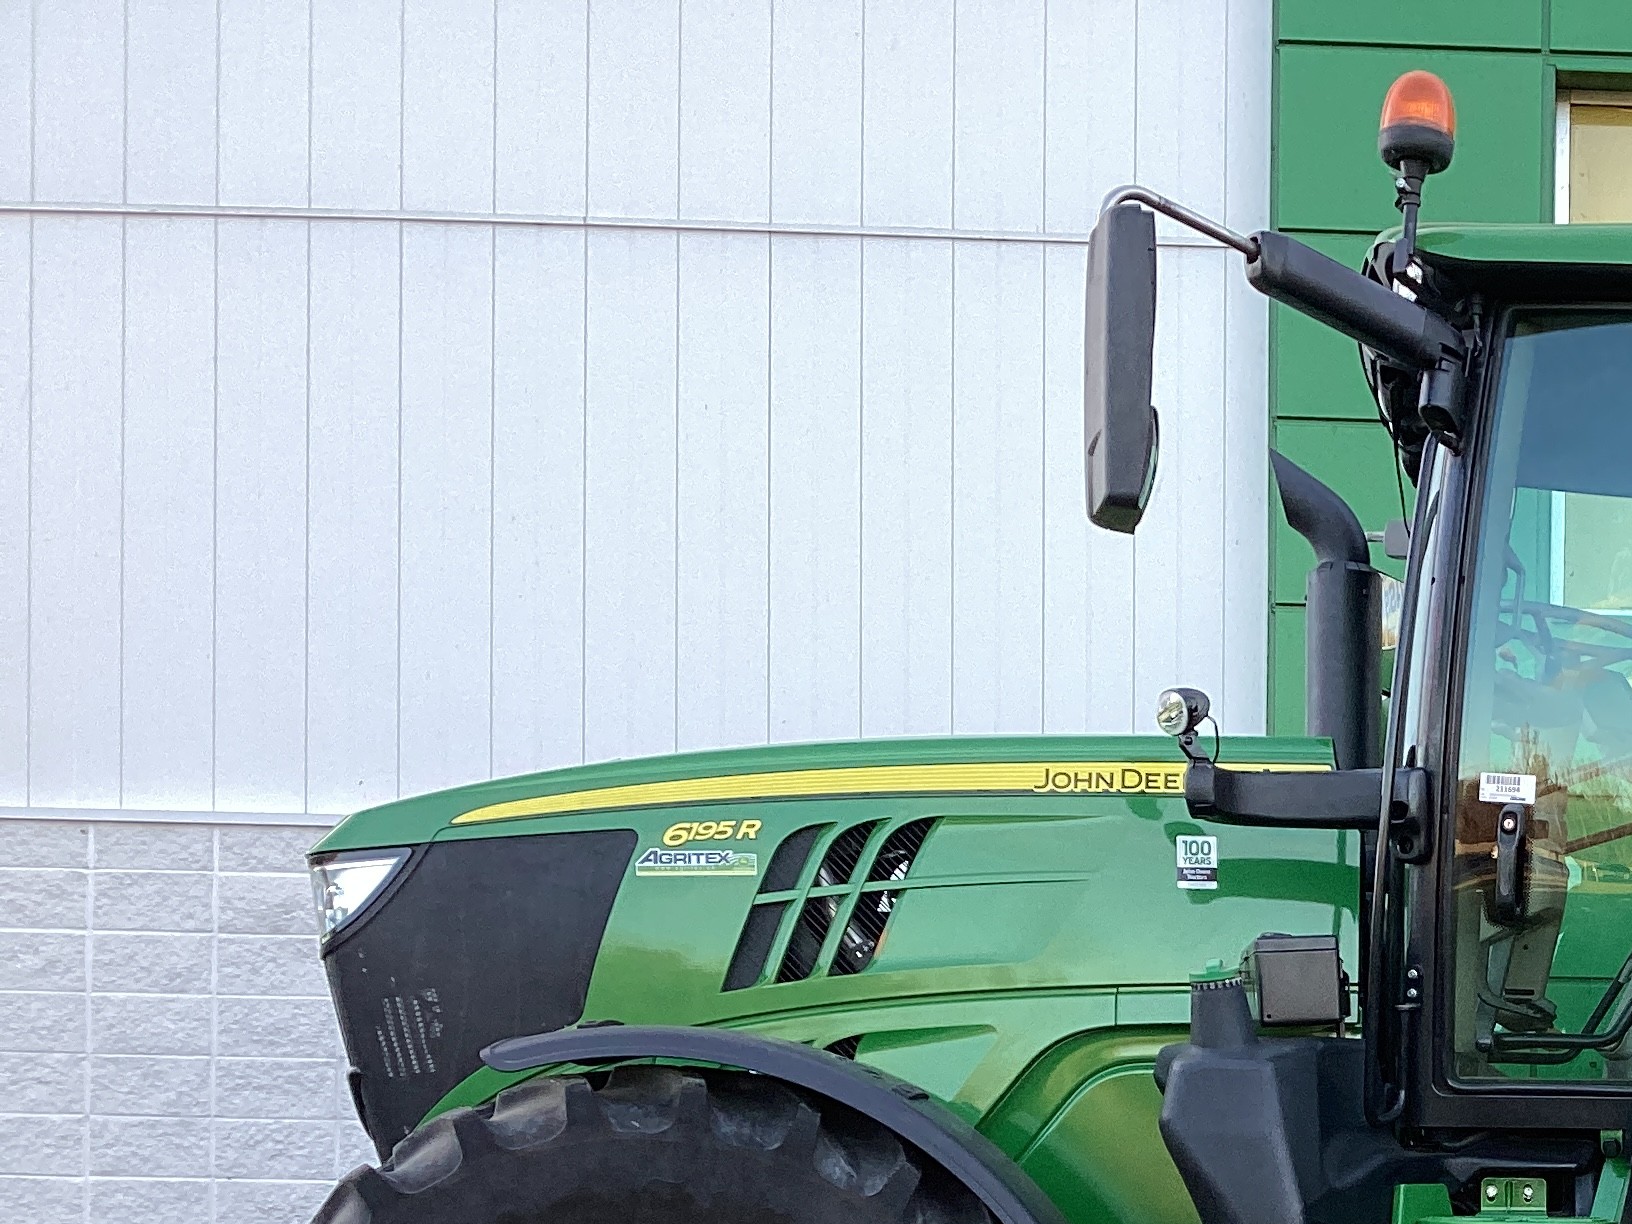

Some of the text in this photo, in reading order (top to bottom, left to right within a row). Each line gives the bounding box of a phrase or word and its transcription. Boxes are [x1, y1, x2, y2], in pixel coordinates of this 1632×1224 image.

[1033, 767, 1186, 791] JOHN DEE
[1181, 839, 1212, 856] 100
[638, 850, 731, 865] AGRITEX
[1182, 856, 1212, 866] YEARS
